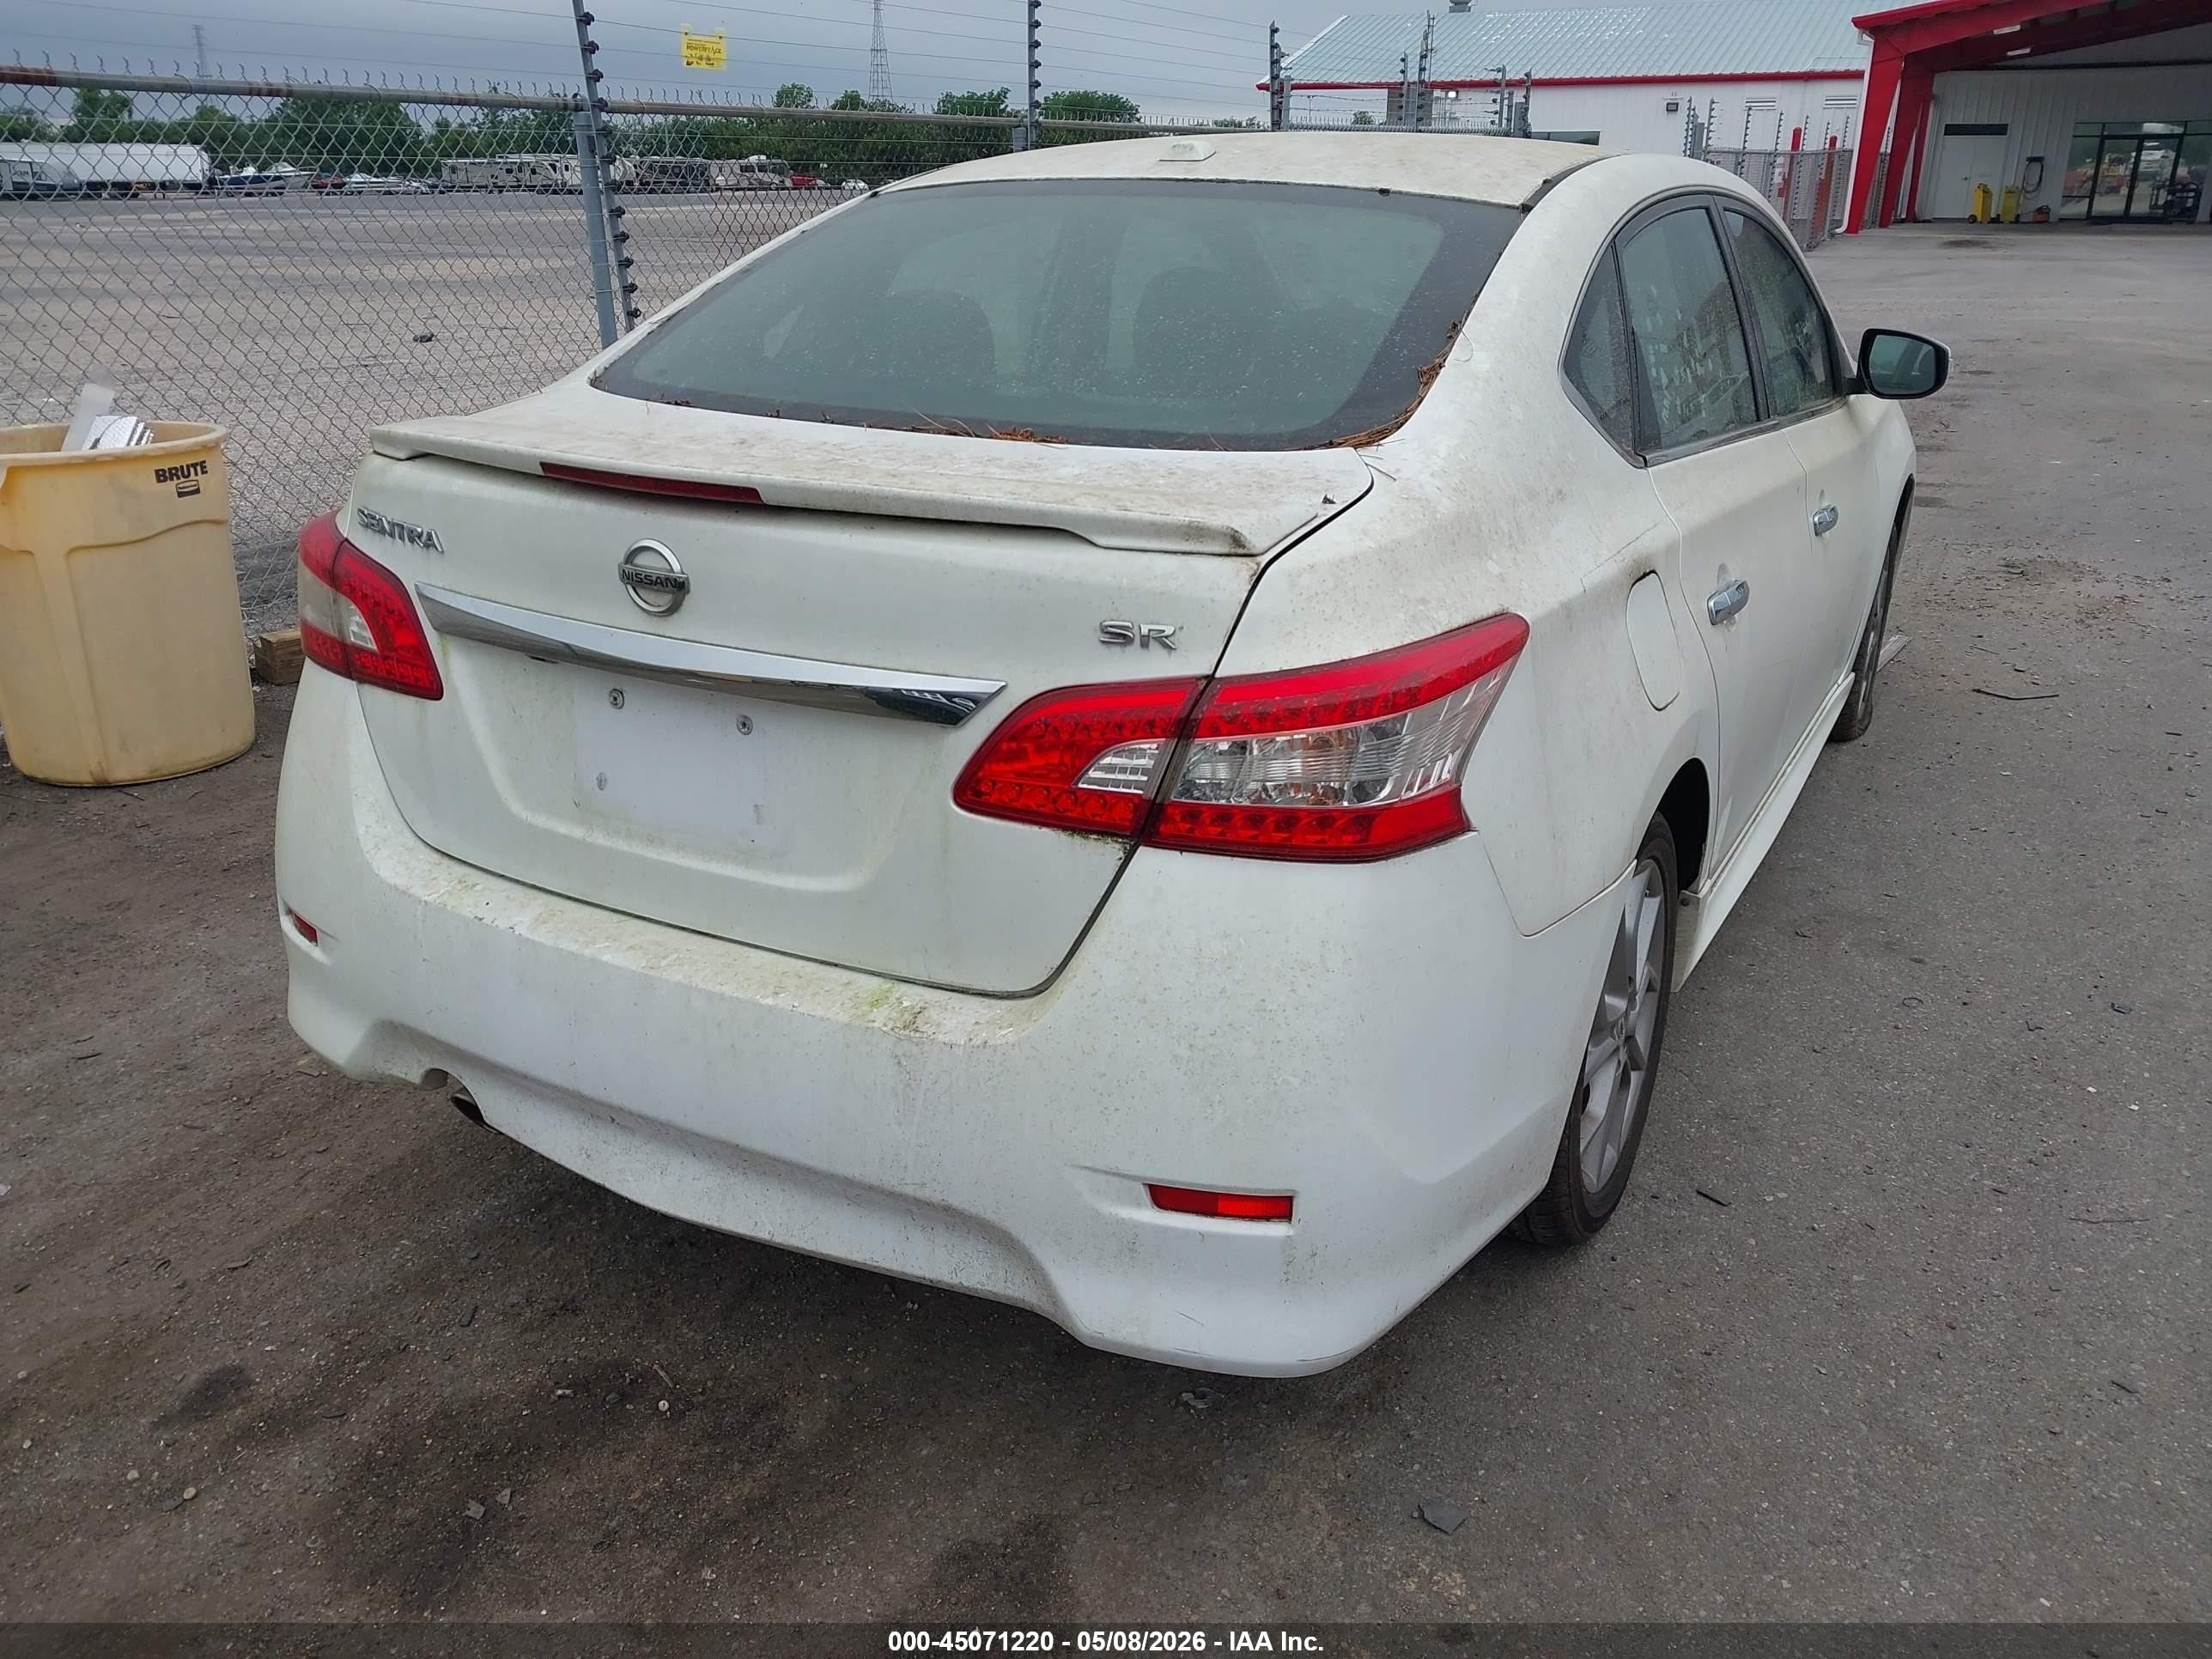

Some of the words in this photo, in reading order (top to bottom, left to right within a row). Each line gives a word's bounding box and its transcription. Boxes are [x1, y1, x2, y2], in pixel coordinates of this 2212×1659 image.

[155, 459, 208, 483] BRUTE
[357, 507, 444, 554] SENTRA
[622, 568, 677, 589] NISSAN
[1099, 620, 1176, 650] SR
